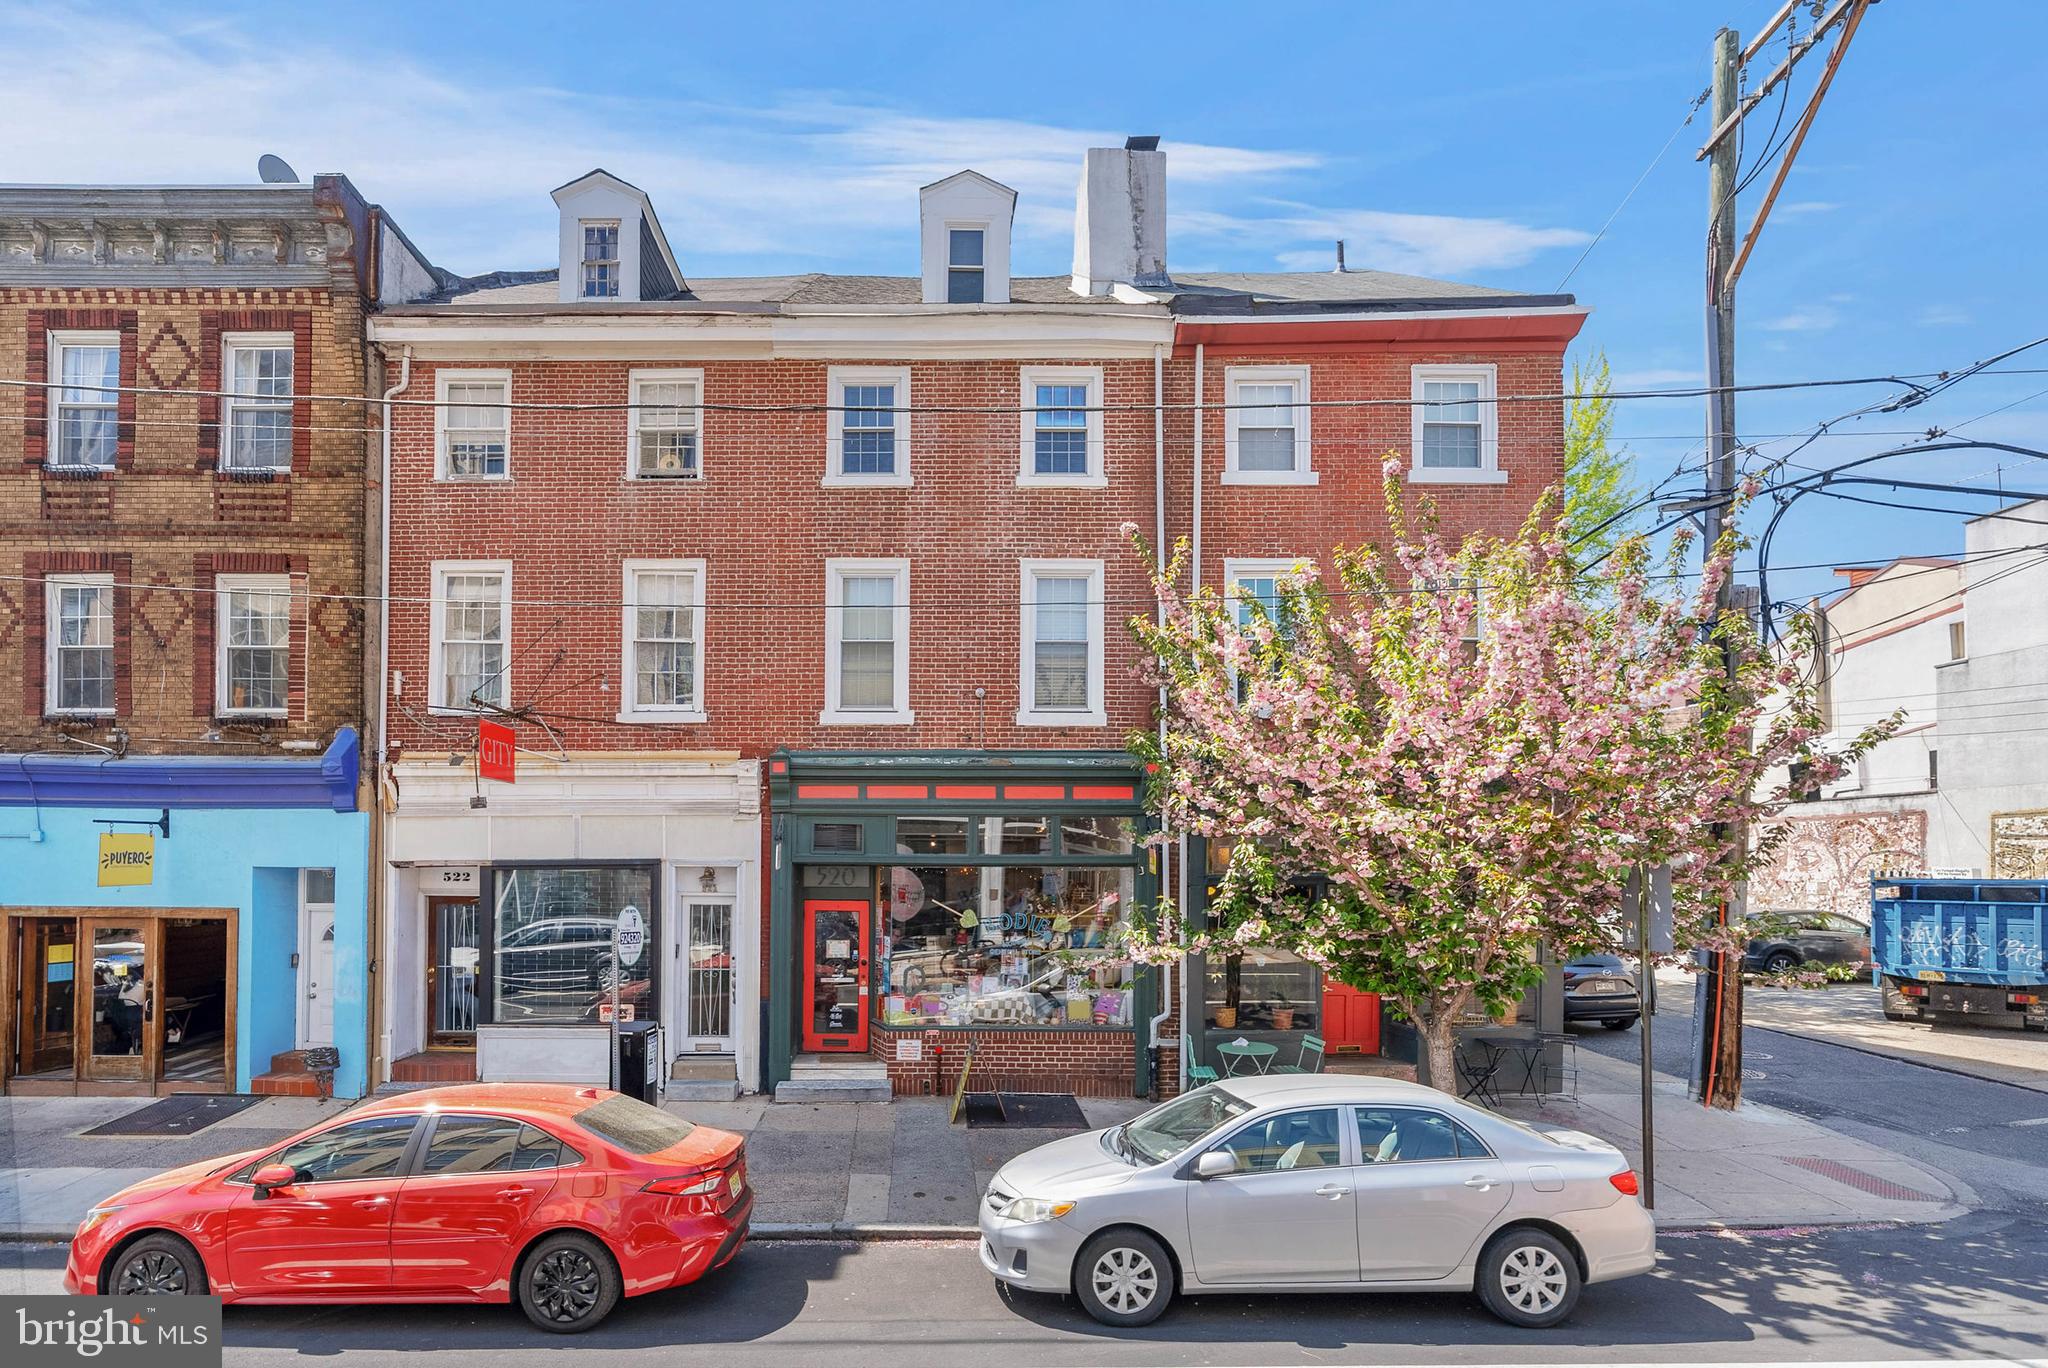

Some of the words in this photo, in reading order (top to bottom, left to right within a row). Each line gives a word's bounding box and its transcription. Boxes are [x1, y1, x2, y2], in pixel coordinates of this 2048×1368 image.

[110, 850, 145, 865] PUYERO
[443, 871, 471, 882] 522
[816, 867, 856, 886] 520
